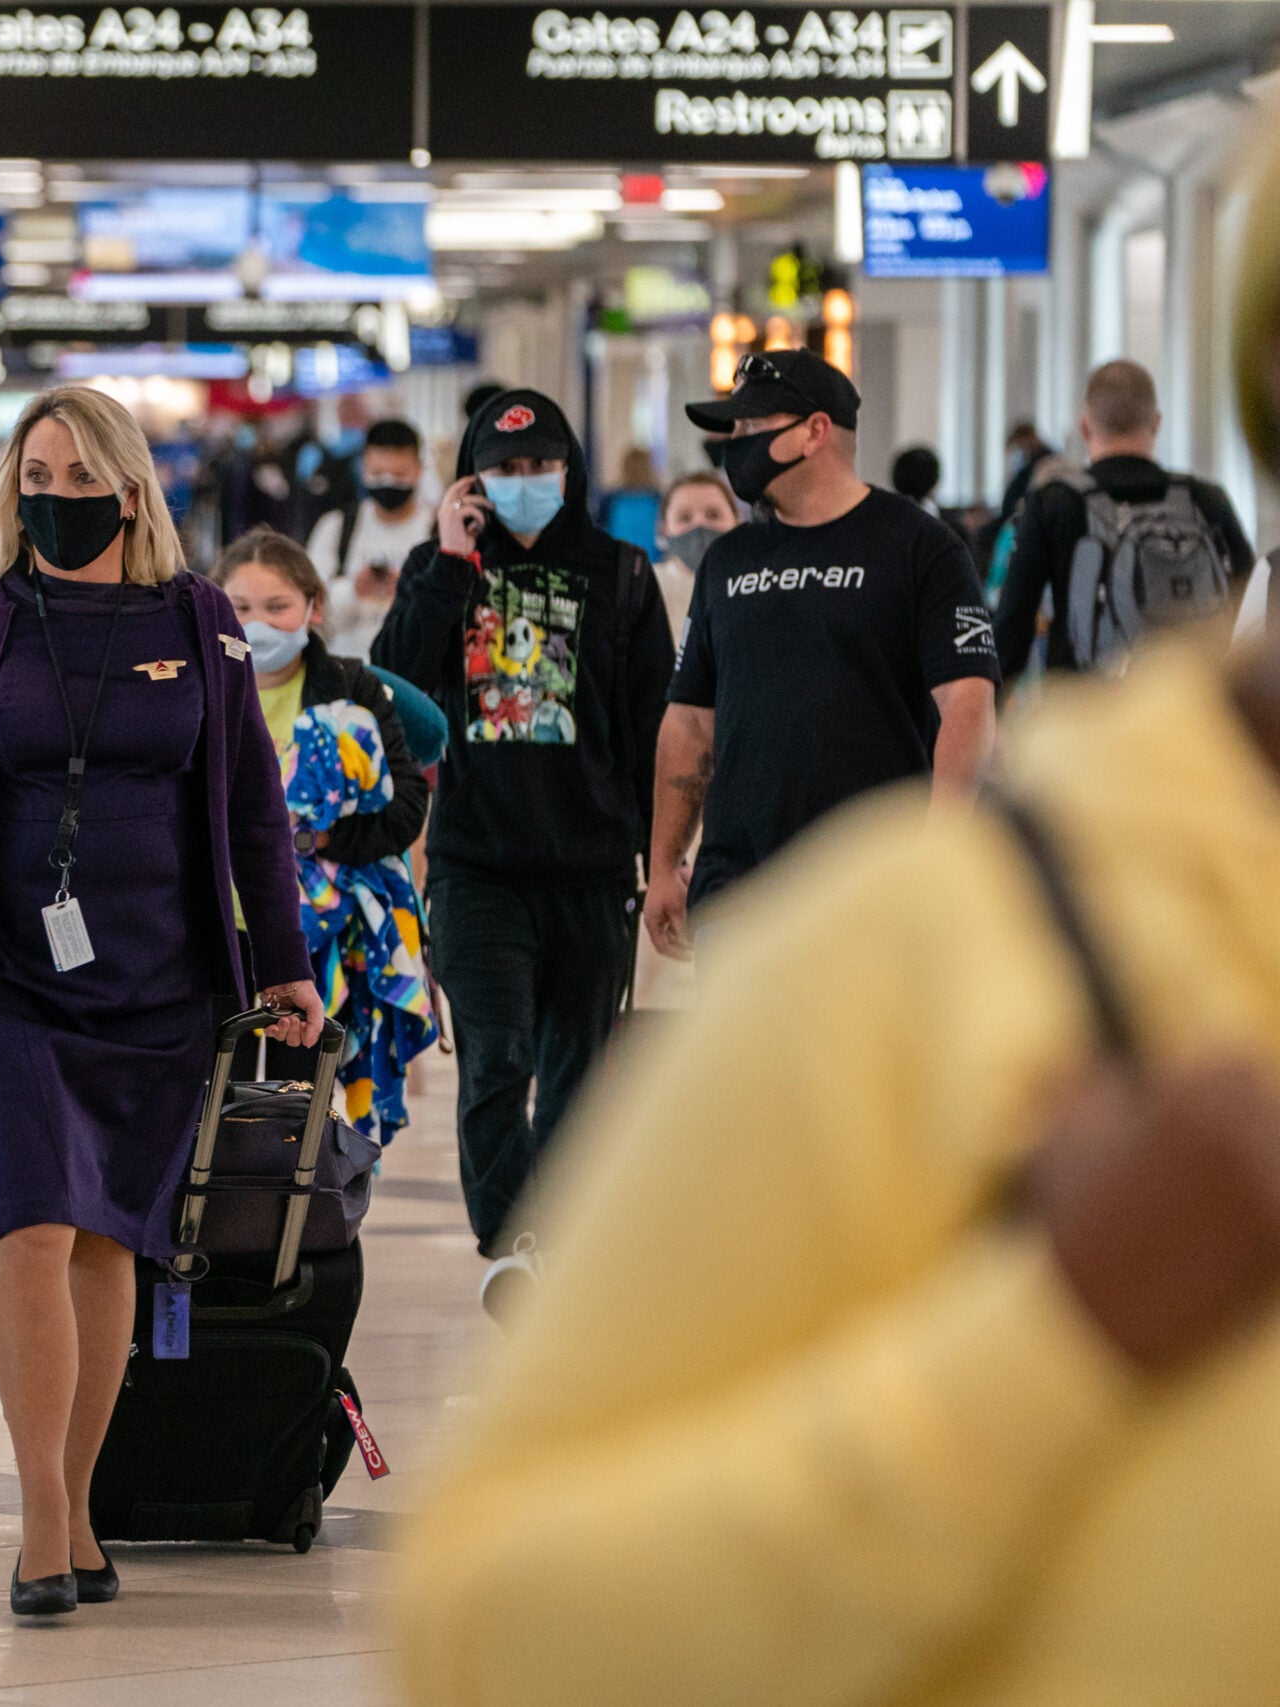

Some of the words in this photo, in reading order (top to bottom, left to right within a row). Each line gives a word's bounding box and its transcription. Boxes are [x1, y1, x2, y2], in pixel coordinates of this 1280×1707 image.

[89, 7, 184, 50] A24
[216, 7, 313, 52] A34
[532, 9, 661, 53] Gates
[665, 9, 760, 53] A24
[793, 10, 886, 53] A34
[655, 88, 886, 135] Restrooms
[346, 1408, 382, 1469] CREW
